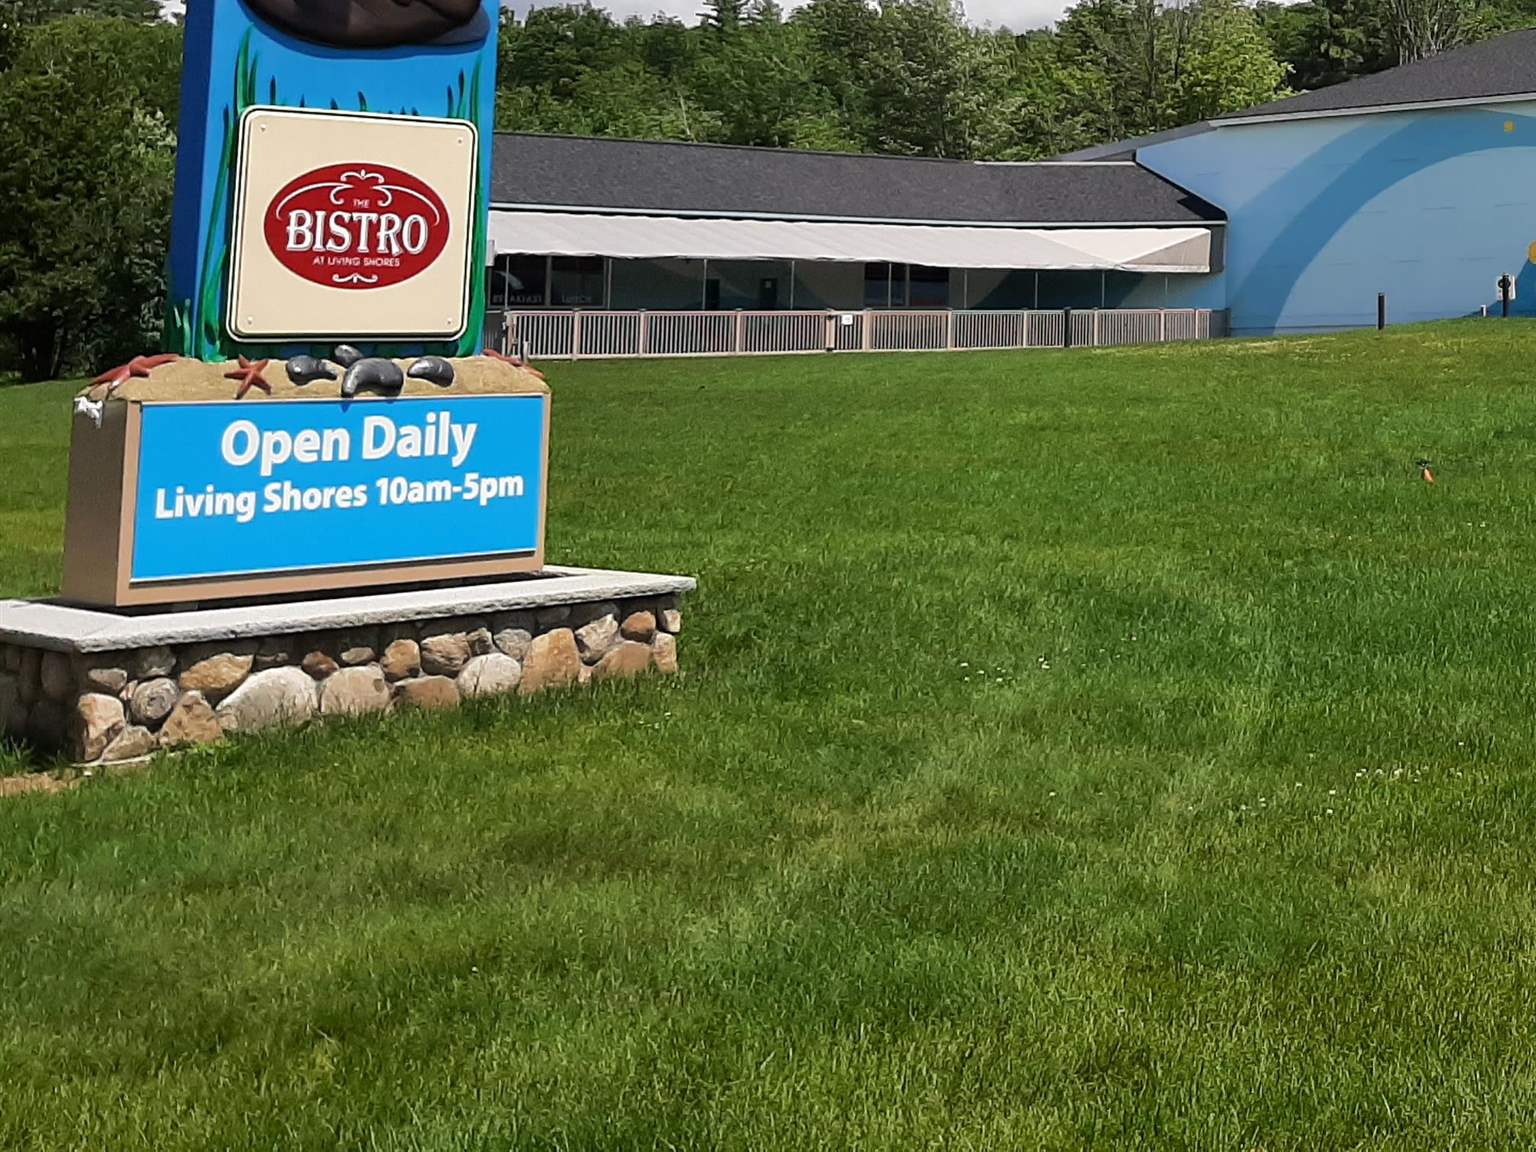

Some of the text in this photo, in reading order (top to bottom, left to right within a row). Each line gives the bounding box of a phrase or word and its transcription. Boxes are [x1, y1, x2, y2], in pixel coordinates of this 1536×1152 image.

[353, 198, 370, 208] THE
[286, 209, 428, 257] BISTRO
[220, 411, 478, 477] Open Daily
[155, 472, 524, 522] Living Shores 10am-5pm
